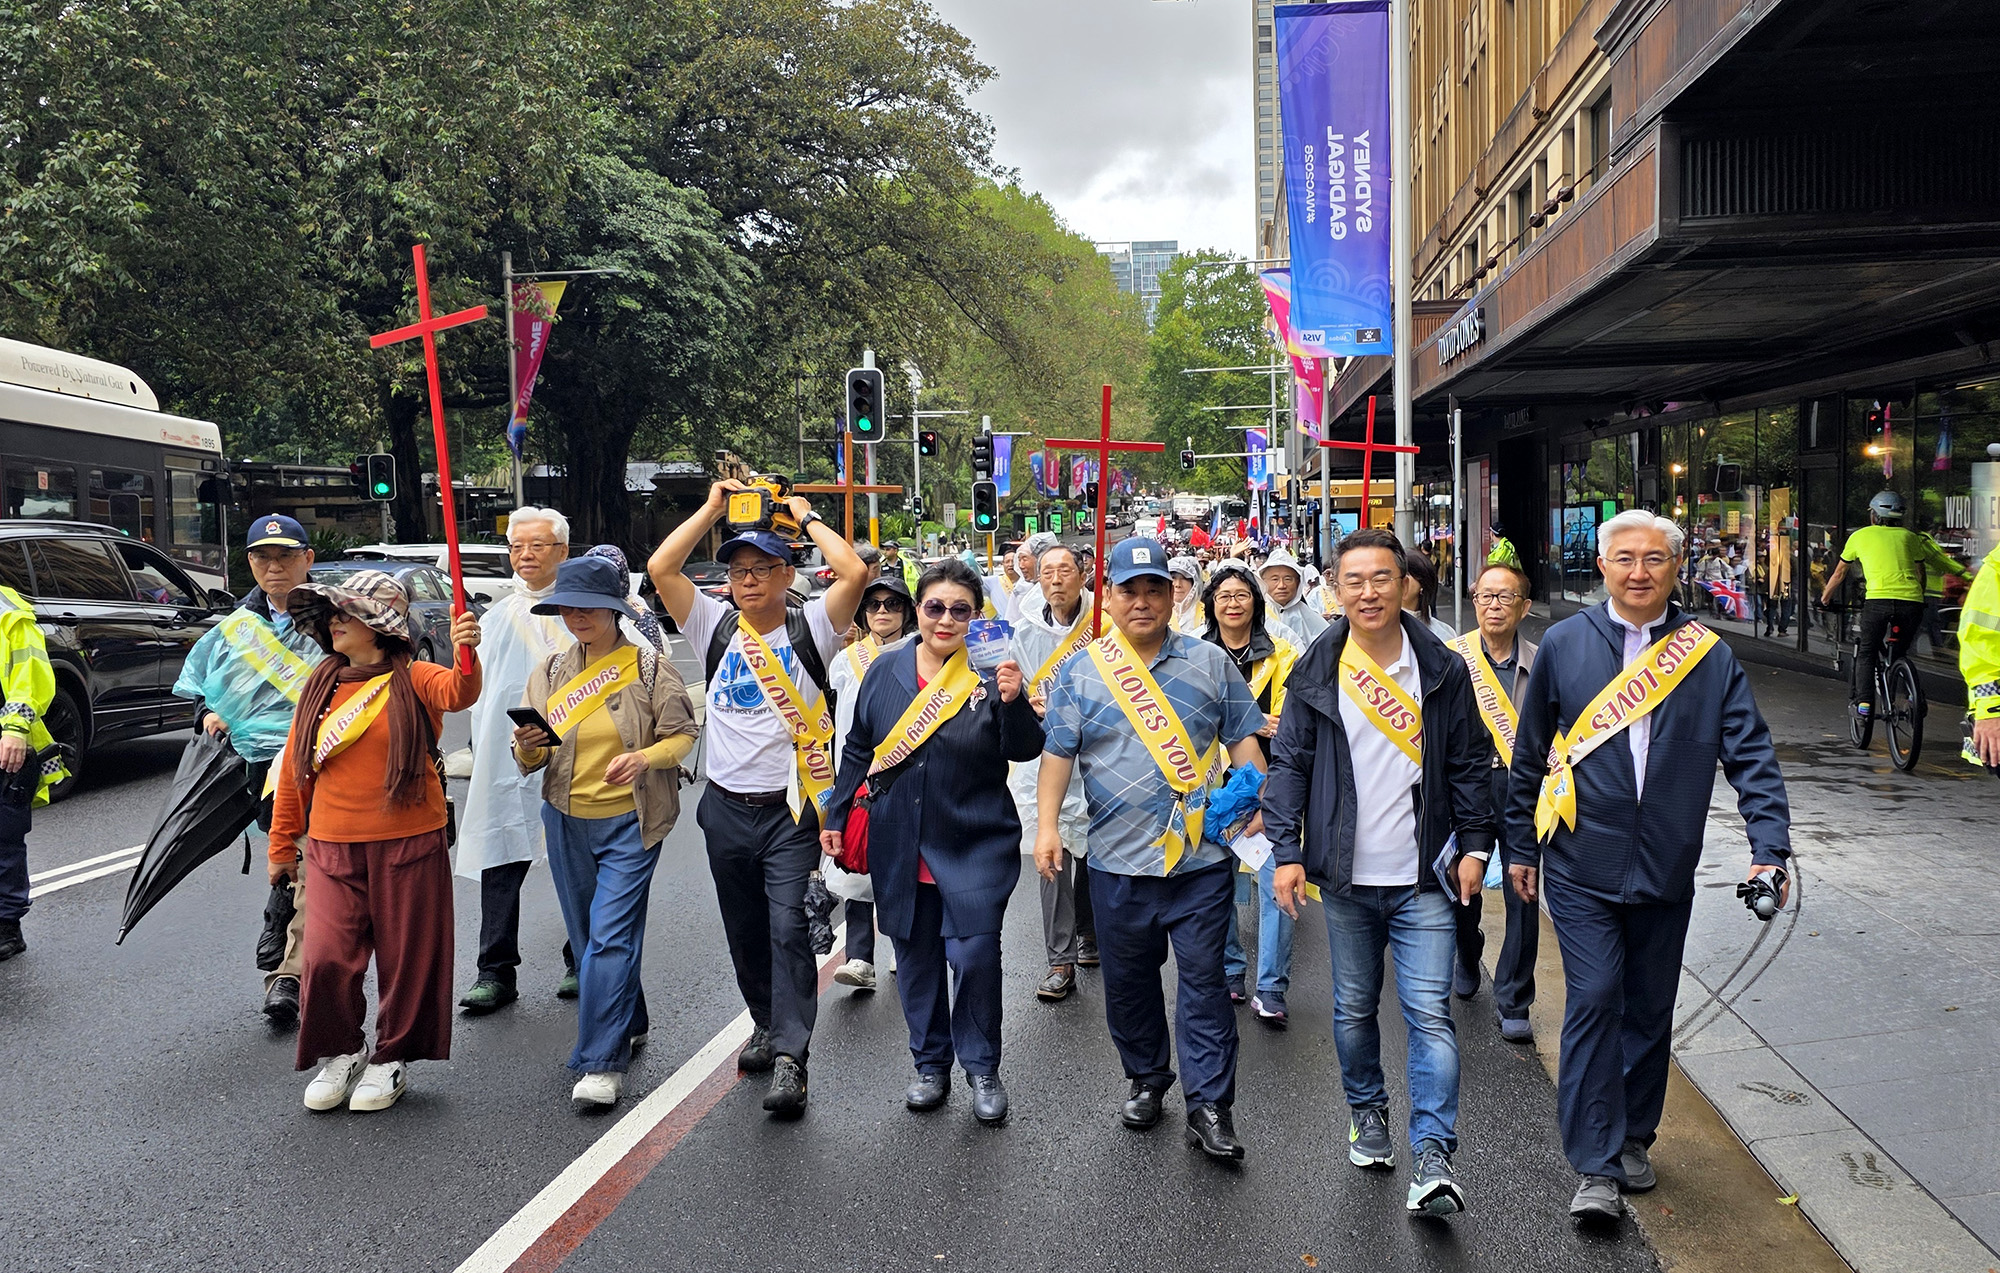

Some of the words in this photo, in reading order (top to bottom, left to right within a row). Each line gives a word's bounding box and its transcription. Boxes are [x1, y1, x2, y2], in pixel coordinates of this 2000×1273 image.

[108, 375, 124, 391] Gas
[201, 437, 216, 449] 1895
[1945, 496, 1971, 529] WHO
[266, 651, 296, 682] Holy
[566, 665, 621, 710] Sydney
[906, 687, 953, 743] Sydney
[1349, 668, 1416, 732] JESUS
[1476, 684, 1499, 712] City
[1592, 668, 1659, 731] LOVES
[1112, 664, 1170, 733] LOVES
[1160, 736, 1197, 782] YOU
[802, 738, 832, 781] YOU
